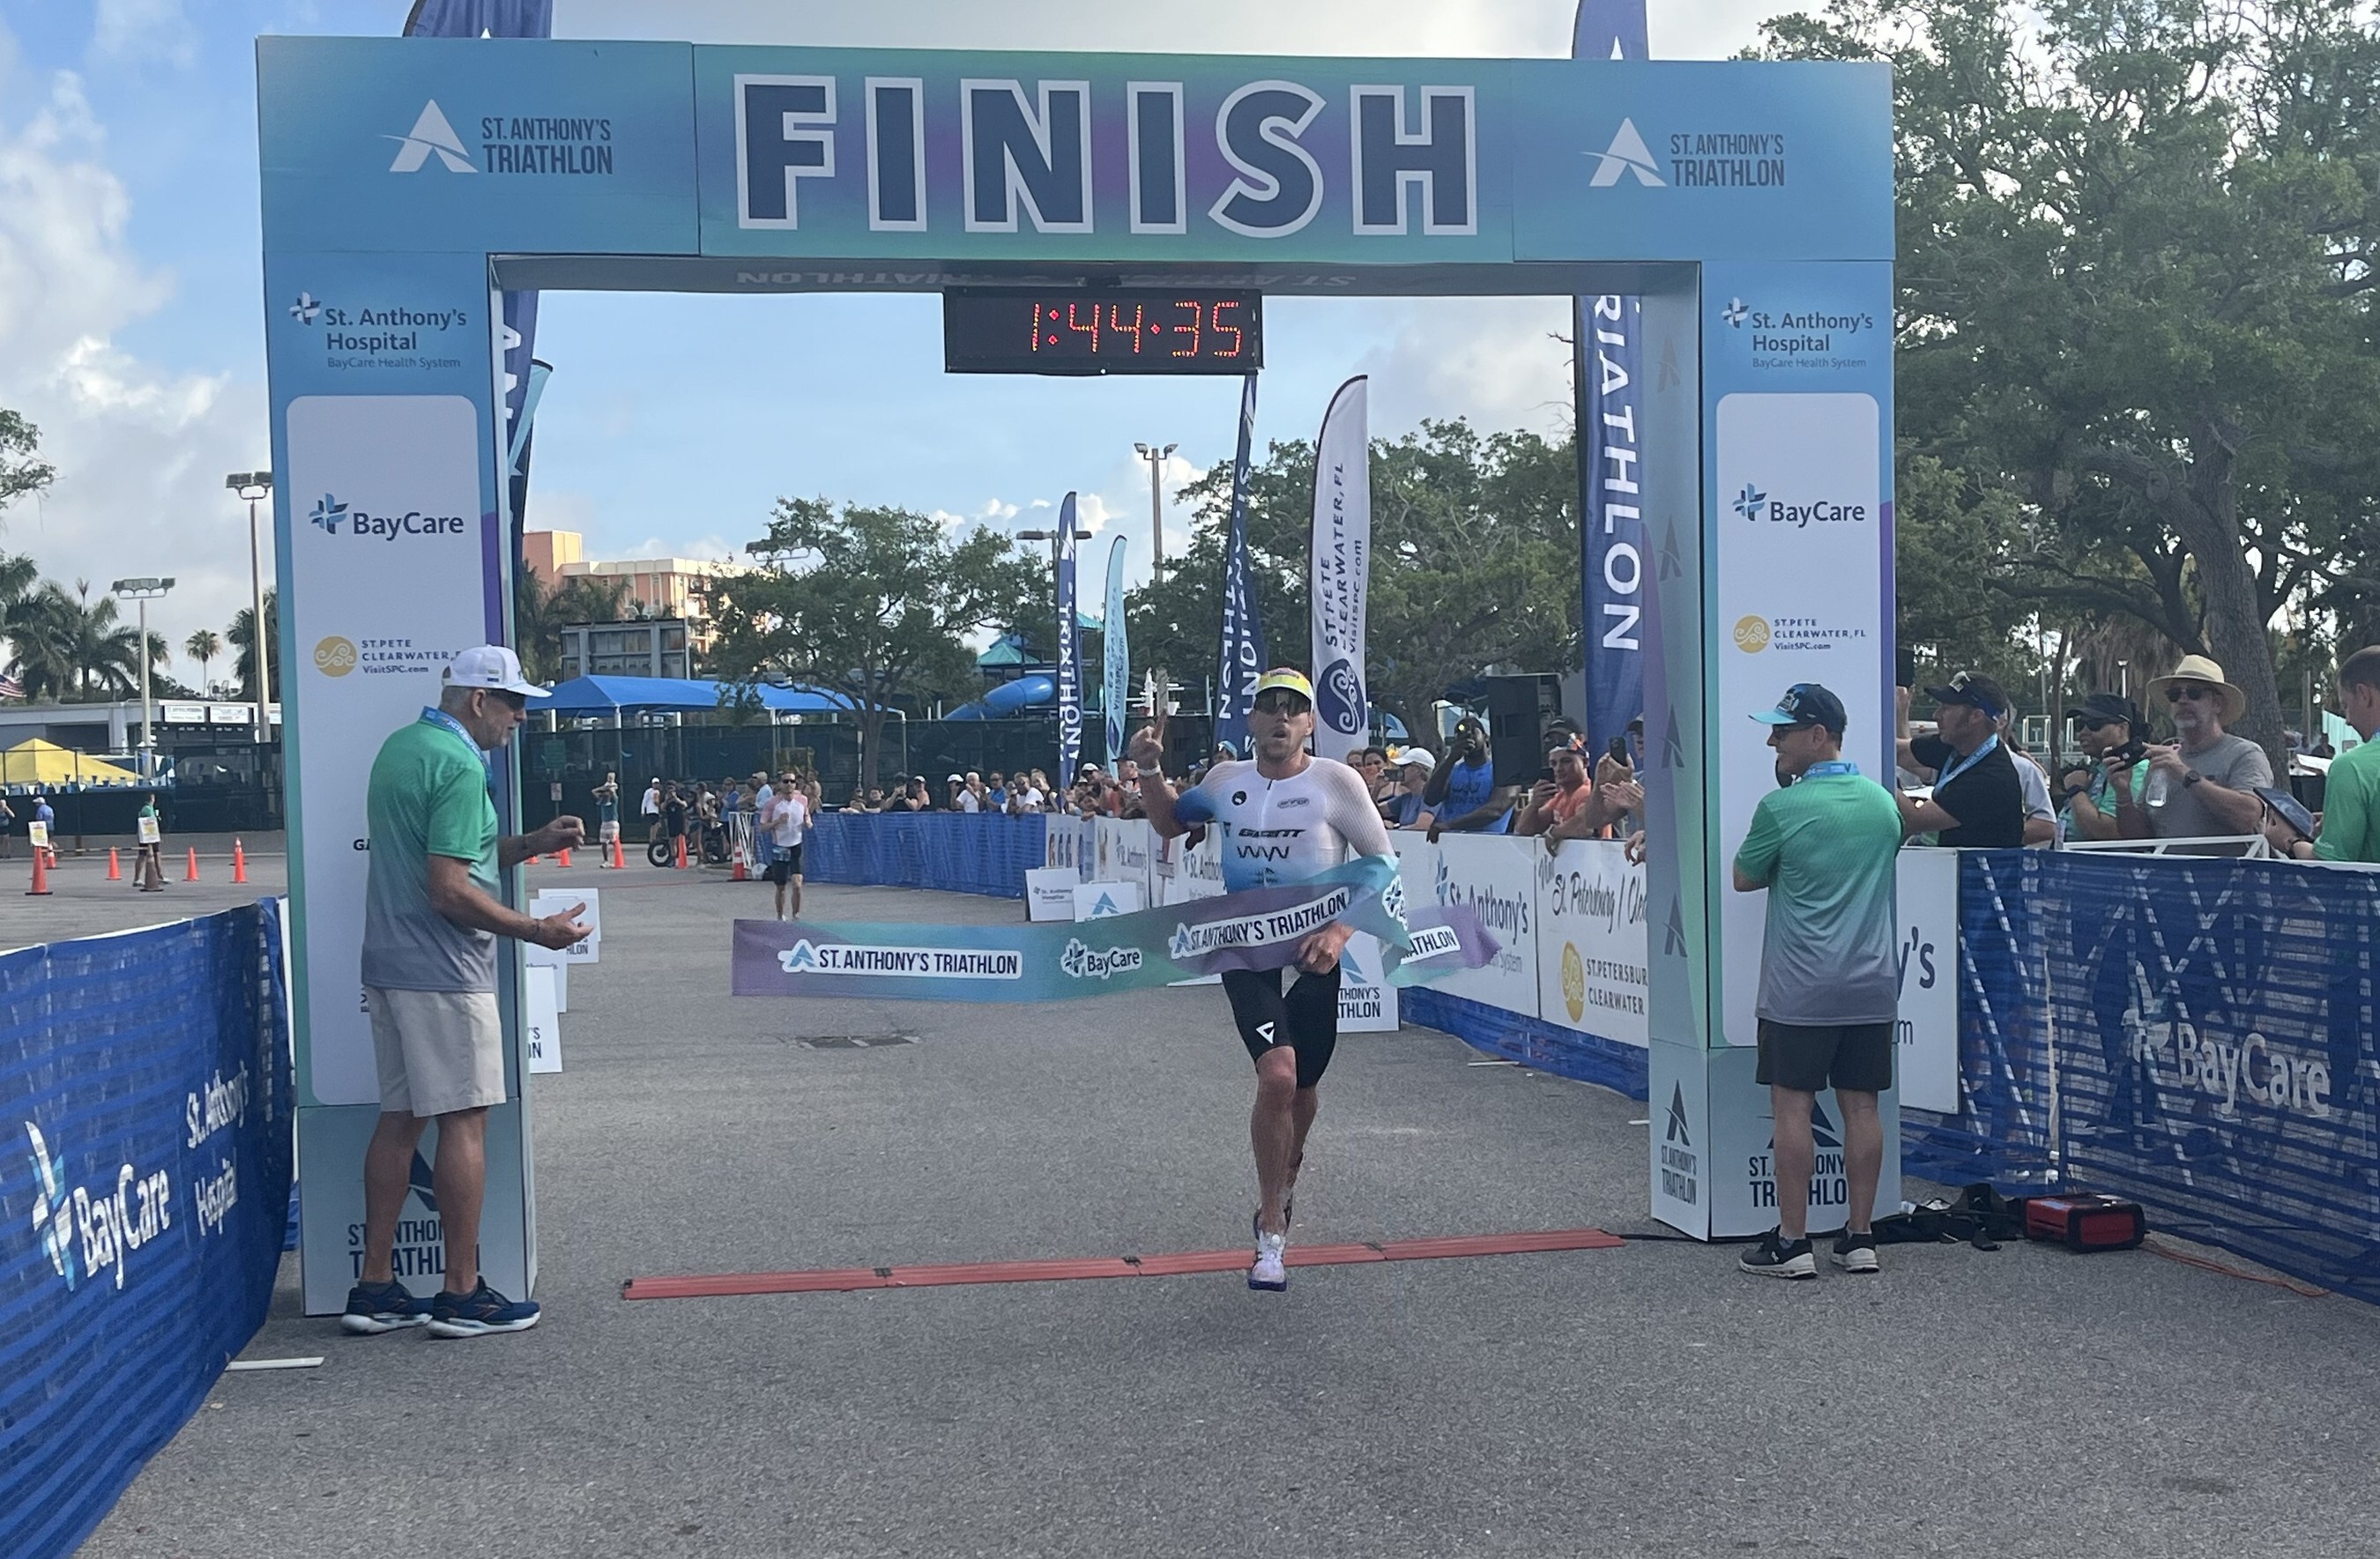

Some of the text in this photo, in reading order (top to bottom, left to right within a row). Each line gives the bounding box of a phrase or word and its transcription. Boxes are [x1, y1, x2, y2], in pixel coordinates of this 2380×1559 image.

[481, 116, 612, 142] ST. ANTHONY'S
[733, 74, 1476, 238] FINISH
[1670, 134, 1784, 155] ST. ANTHONY'S
[483, 145, 614, 174] TRIATHLON
[1671, 159, 1785, 187] TRIATHLON
[325, 307, 467, 330] St. Anthony's
[1752, 312, 1873, 333] St. Anthony's
[326, 332, 417, 355] Hospital
[1752, 335, 1830, 355] Hospital
[327, 357, 461, 370] BayCare Health System
[1752, 358, 1867, 369] BayCare Health System
[1594, 295, 1642, 651] RIATHLON
[353, 512, 464, 541] BayCare
[1770, 501, 1865, 528] BayCare
[1269, 892, 1347, 941] TRIATHLON
[819, 949, 1018, 975] ST. ANTHONY'S TRIATHLON
[1087, 949, 1140, 972] BayCare
[1588, 987, 1645, 1015] CLEARWATER
[2177, 1021, 2331, 1116] BayCare
[1749, 1156, 1771, 1177] ST.
[73, 1163, 170, 1290] BayCare
